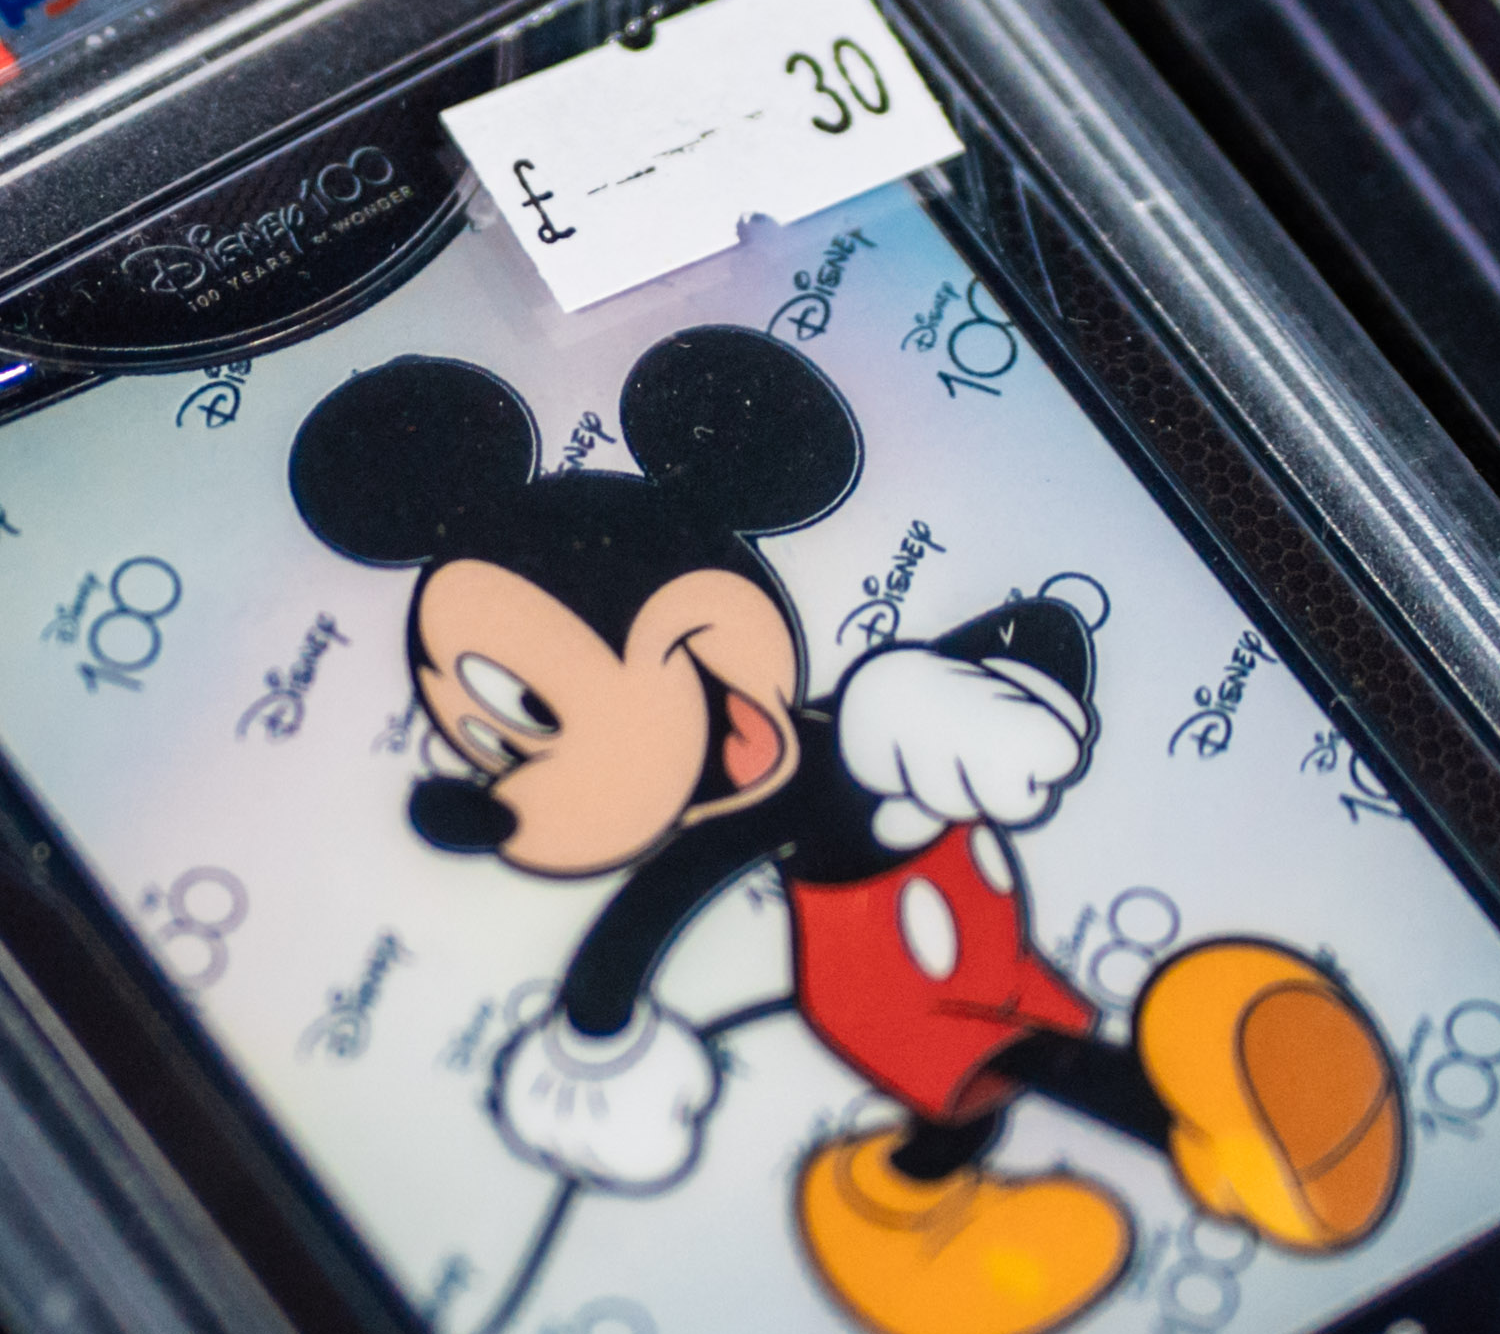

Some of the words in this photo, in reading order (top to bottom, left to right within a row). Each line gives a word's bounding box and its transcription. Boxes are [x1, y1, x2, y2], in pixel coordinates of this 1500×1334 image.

[512, 157, 577, 245] £
[785, 37, 891, 135] 30
[227, 250, 294, 291] YEARS
[333, 183, 415, 233] WONDER
[77, 554, 183, 695] 100
[1168, 629, 1279, 759] Disney
